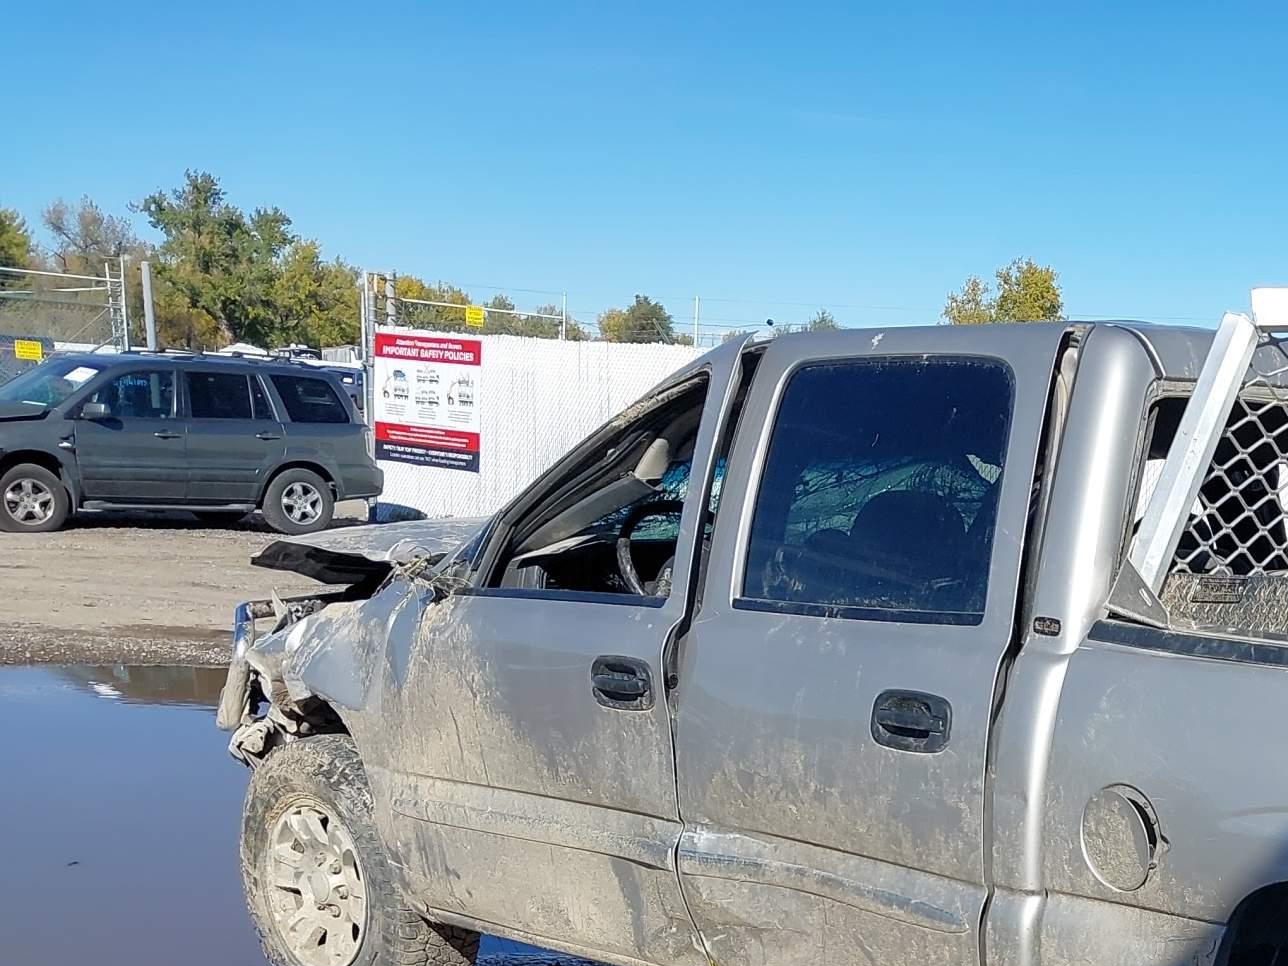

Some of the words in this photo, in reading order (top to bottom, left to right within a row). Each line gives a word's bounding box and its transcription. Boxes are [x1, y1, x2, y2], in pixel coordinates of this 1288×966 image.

[383, 345, 419, 358] IMPORTANT
[420, 348, 444, 359] SAFETY
[444, 350, 474, 362] POLICIES
